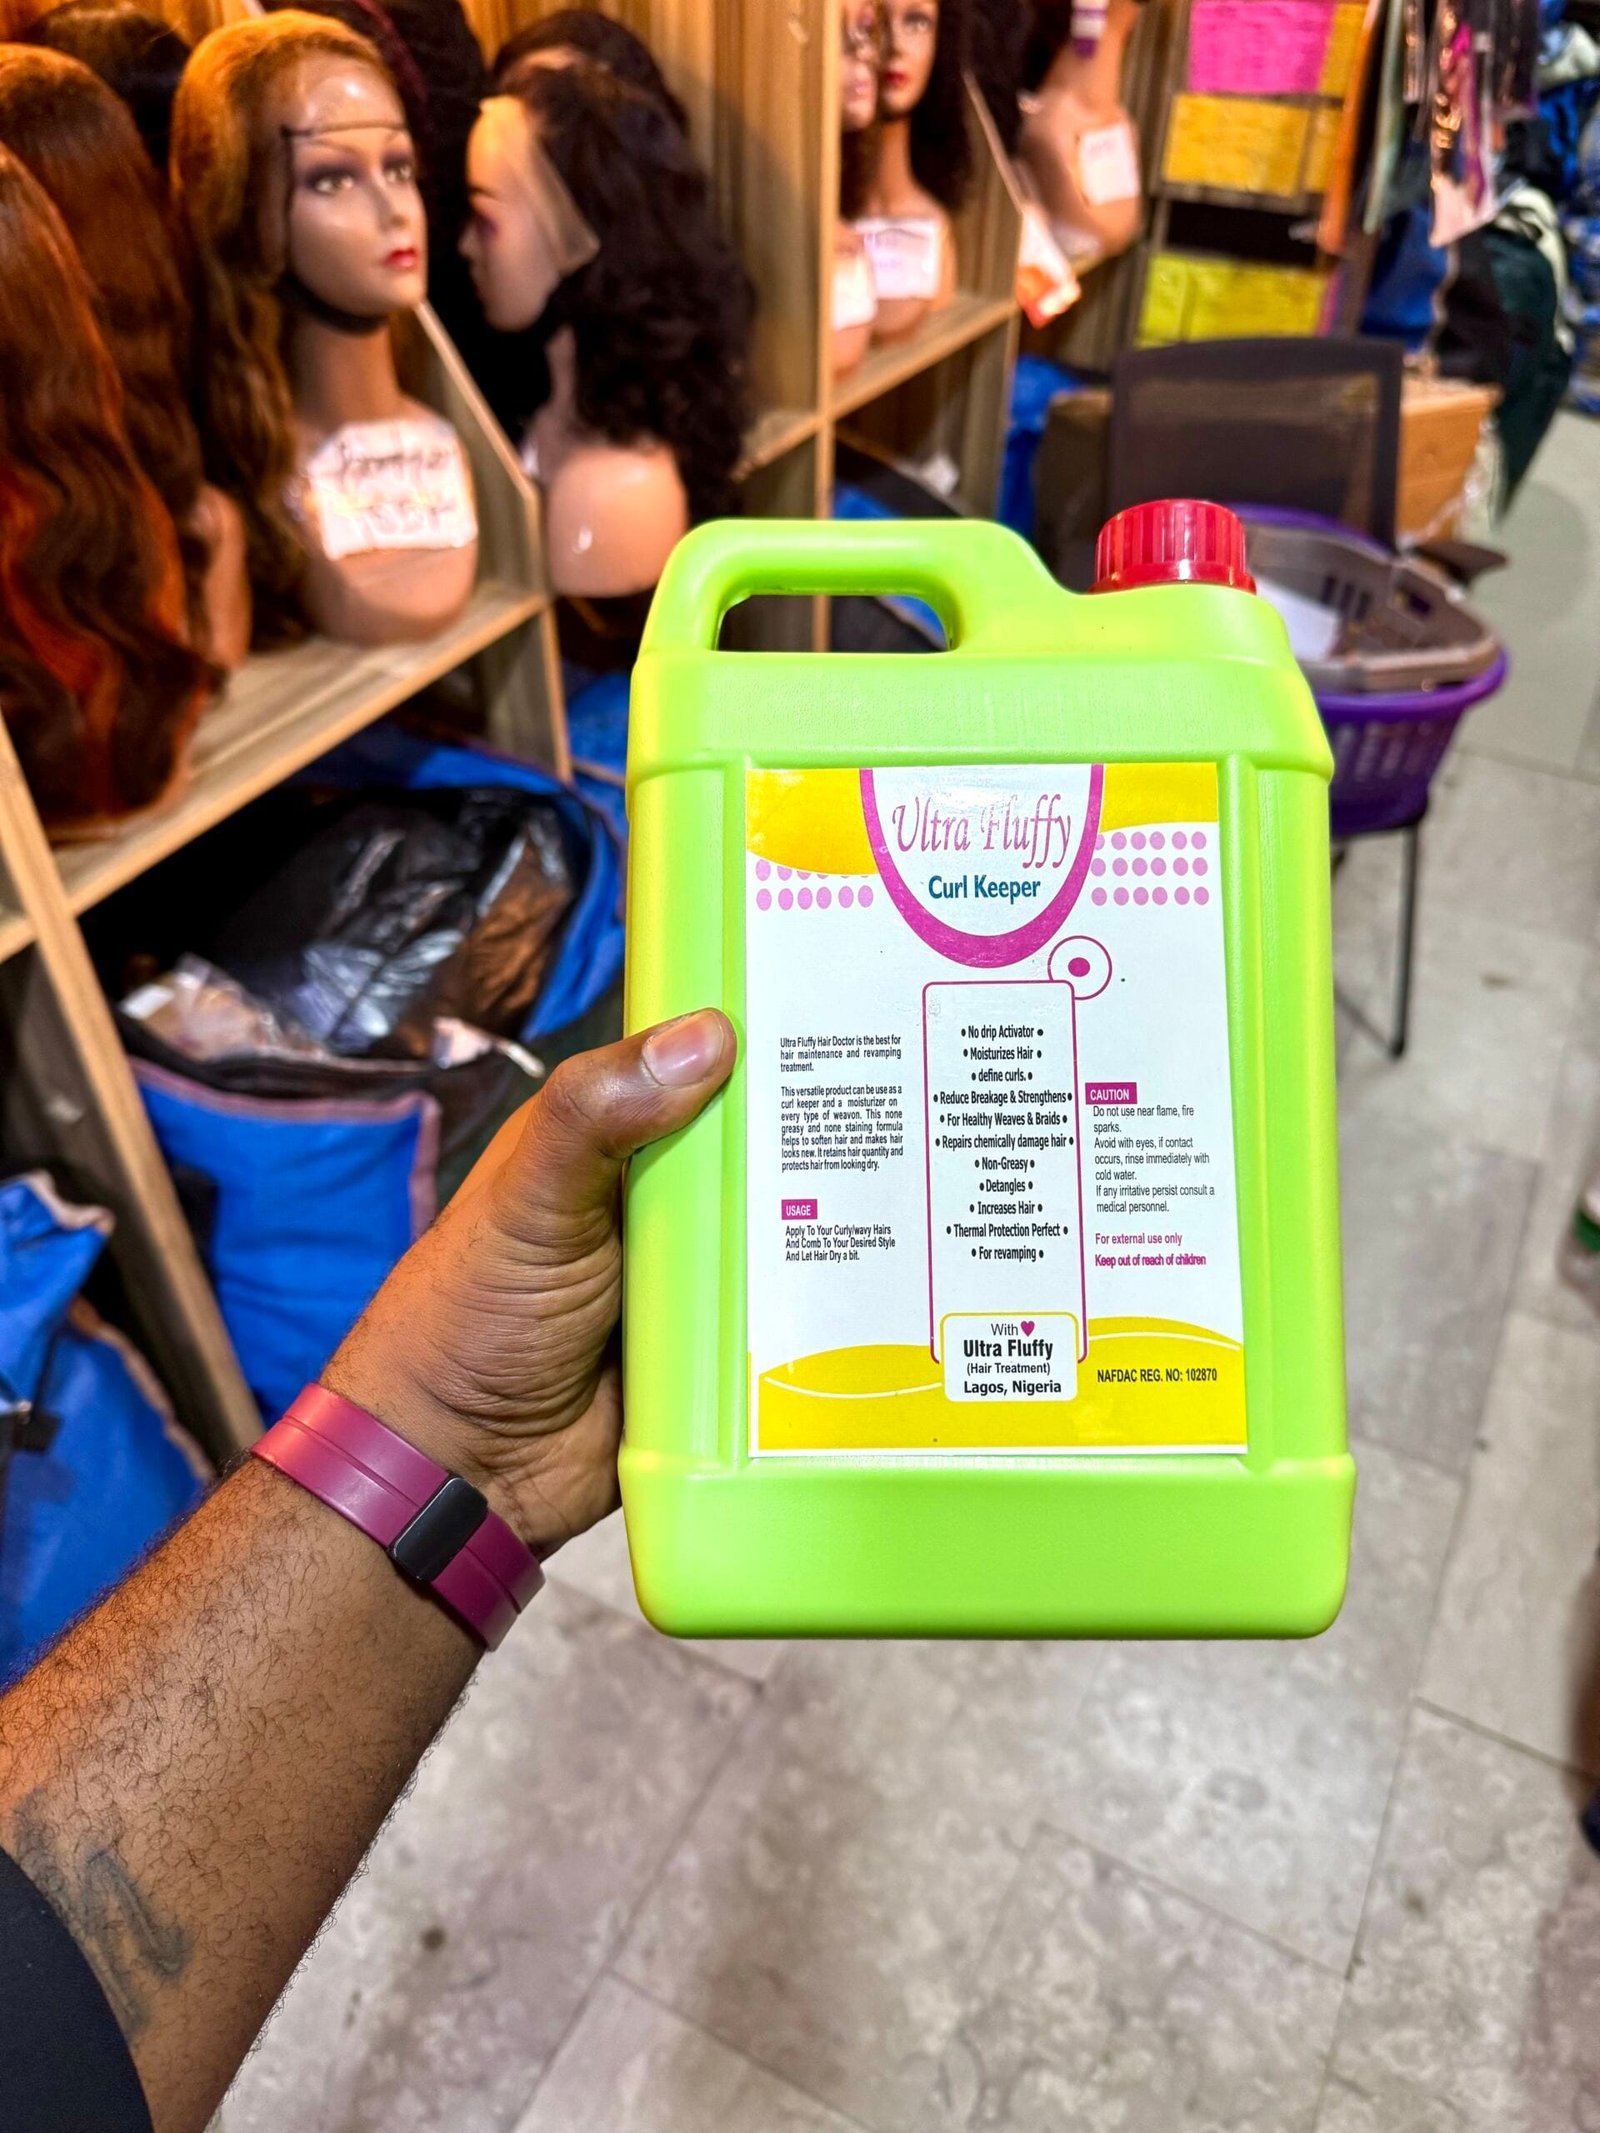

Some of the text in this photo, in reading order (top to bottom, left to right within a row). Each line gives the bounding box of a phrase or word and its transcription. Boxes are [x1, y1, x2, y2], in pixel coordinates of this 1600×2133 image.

[892, 794, 1071, 869] Ultra Fluffy
[928, 874, 1041, 905] Curl Keeper
[968, 1025, 1034, 1041] No drip Activator
[780, 1034, 901, 1049] Ultra Fluffy Hair Doctor is the best for
[780, 1047, 901, 1060] hair maintenance and revamping
[970, 1046, 1033, 1061] Moisturizes Hair
[978, 1068, 1026, 1082] define curls.
[781, 1084, 902, 1098] This versatile product can be use as a
[940, 1089, 1066, 1107] Reduce Breakage & Strengthens
[1090, 1089, 1129, 1101] CAUTION
[781, 1099, 794, 1109] curl
[797, 1099, 819, 1110] keeper
[822, 1098, 835, 1107] and
[848, 1097, 886, 1107] moisturizer
[889, 1098, 897, 1106] on
[781, 1113, 800, 1123] every
[804, 1112, 818, 1123] type
[823, 1110, 830, 1120] of
[866, 1109, 881, 1119] This
[885, 1110, 902, 1119] none
[1093, 1106, 1105, 1117] Do
[1107, 1106, 1119, 1117] not
[1121, 1107, 1134, 1116] use
[1137, 1107, 1154, 1116] near
[1182, 1105, 1194, 1115] fire
[947, 1111, 1061, 1129] For Healthy Weaves & Braids
[782, 1121, 903, 1136] greasy and none staining formula
[1093, 1121, 1122, 1135] sparks.
[782, 1133, 903, 1148] helps to soften hair and makes hair
[942, 1133, 1067, 1151] Repairs chemically damage hair
[1094, 1137, 1116, 1149] Avoid
[1118, 1137, 1134, 1148] with
[1158, 1137, 1163, 1148] if
[1165, 1137, 1193, 1148] contact
[782, 1148, 799, 1158] looks
[818, 1148, 822, 1157] It
[823, 1147, 846, 1157] retains
[848, 1147, 860, 1156] hair
[862, 1146, 889, 1158] quantity
[891, 1146, 903, 1156] and
[1125, 1154, 1144, 1164] rinse
[1146, 1152, 1192, 1166] immediately
[1194, 1152, 1209, 1163] with
[782, 1159, 879, 1173] protects hair from looking dry.
[982, 1157, 1029, 1172] Non-Greasy
[1096, 1169, 1137, 1181] cold water.
[986, 1179, 1026, 1195] Detangles
[1096, 1185, 1102, 1196] If
[1103, 1187, 1117, 1199] any
[1152, 1185, 1178, 1198] persist
[1180, 1185, 1207, 1195] consult
[1209, 1186, 1214, 1195] a
[786, 1205, 811, 1216] USAGE
[977, 1201, 1035, 1214] Increases Hair
[1097, 1201, 1169, 1215] medical personnel.
[786, 1226, 805, 1238] Apply
[807, 1225, 815, 1235] To
[817, 1225, 832, 1235] Your
[874, 1224, 891, 1234] Hairs
[954, 1223, 1061, 1238] Thermal Protection Perfect
[786, 1237, 895, 1250] And Comb To Your Desired Style
[1096, 1233, 1182, 1246] For external use only
[786, 1251, 799, 1261] And
[801, 1251, 812, 1260] Let
[814, 1250, 827, 1260] Hair
[830, 1250, 841, 1263] Dry
[843, 1252, 847, 1260] a
[979, 1246, 1036, 1262] For revamping
[1095, 1254, 1206, 1268] Keep out of reach of children
[991, 1323, 1019, 1336] With
[963, 1339, 1054, 1361] Ultra Fluffy
[966, 1362, 1050, 1375] (Hair Treatment)
[1097, 1368, 1217, 1382] NAFDAC REG. NO: 102870
[964, 1380, 1062, 1396] Lagos, Nigeria
